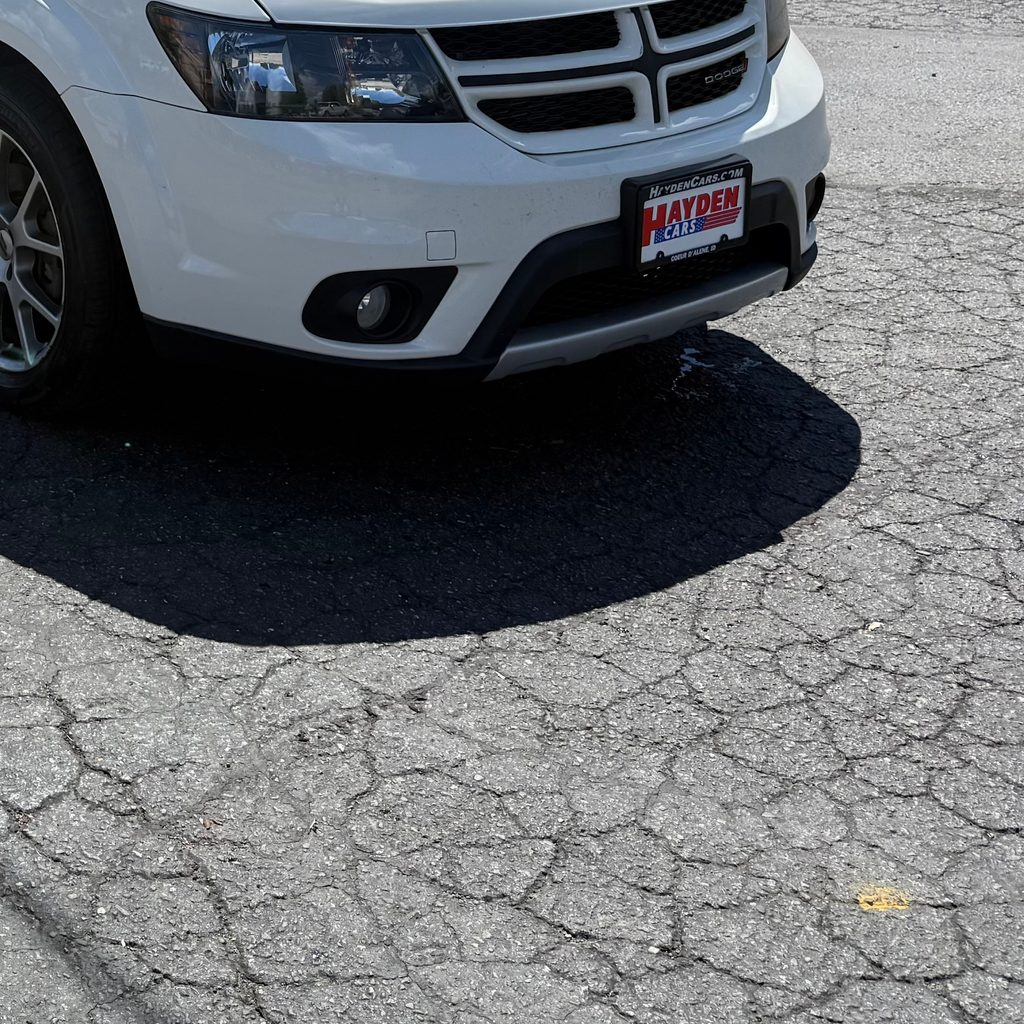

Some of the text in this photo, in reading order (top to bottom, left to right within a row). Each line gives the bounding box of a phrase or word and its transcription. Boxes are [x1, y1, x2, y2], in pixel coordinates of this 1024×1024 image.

[704, 64, 744, 84] DODGE
[641, 185, 740, 248] HAYDEN
[663, 218, 697, 240] CARS
